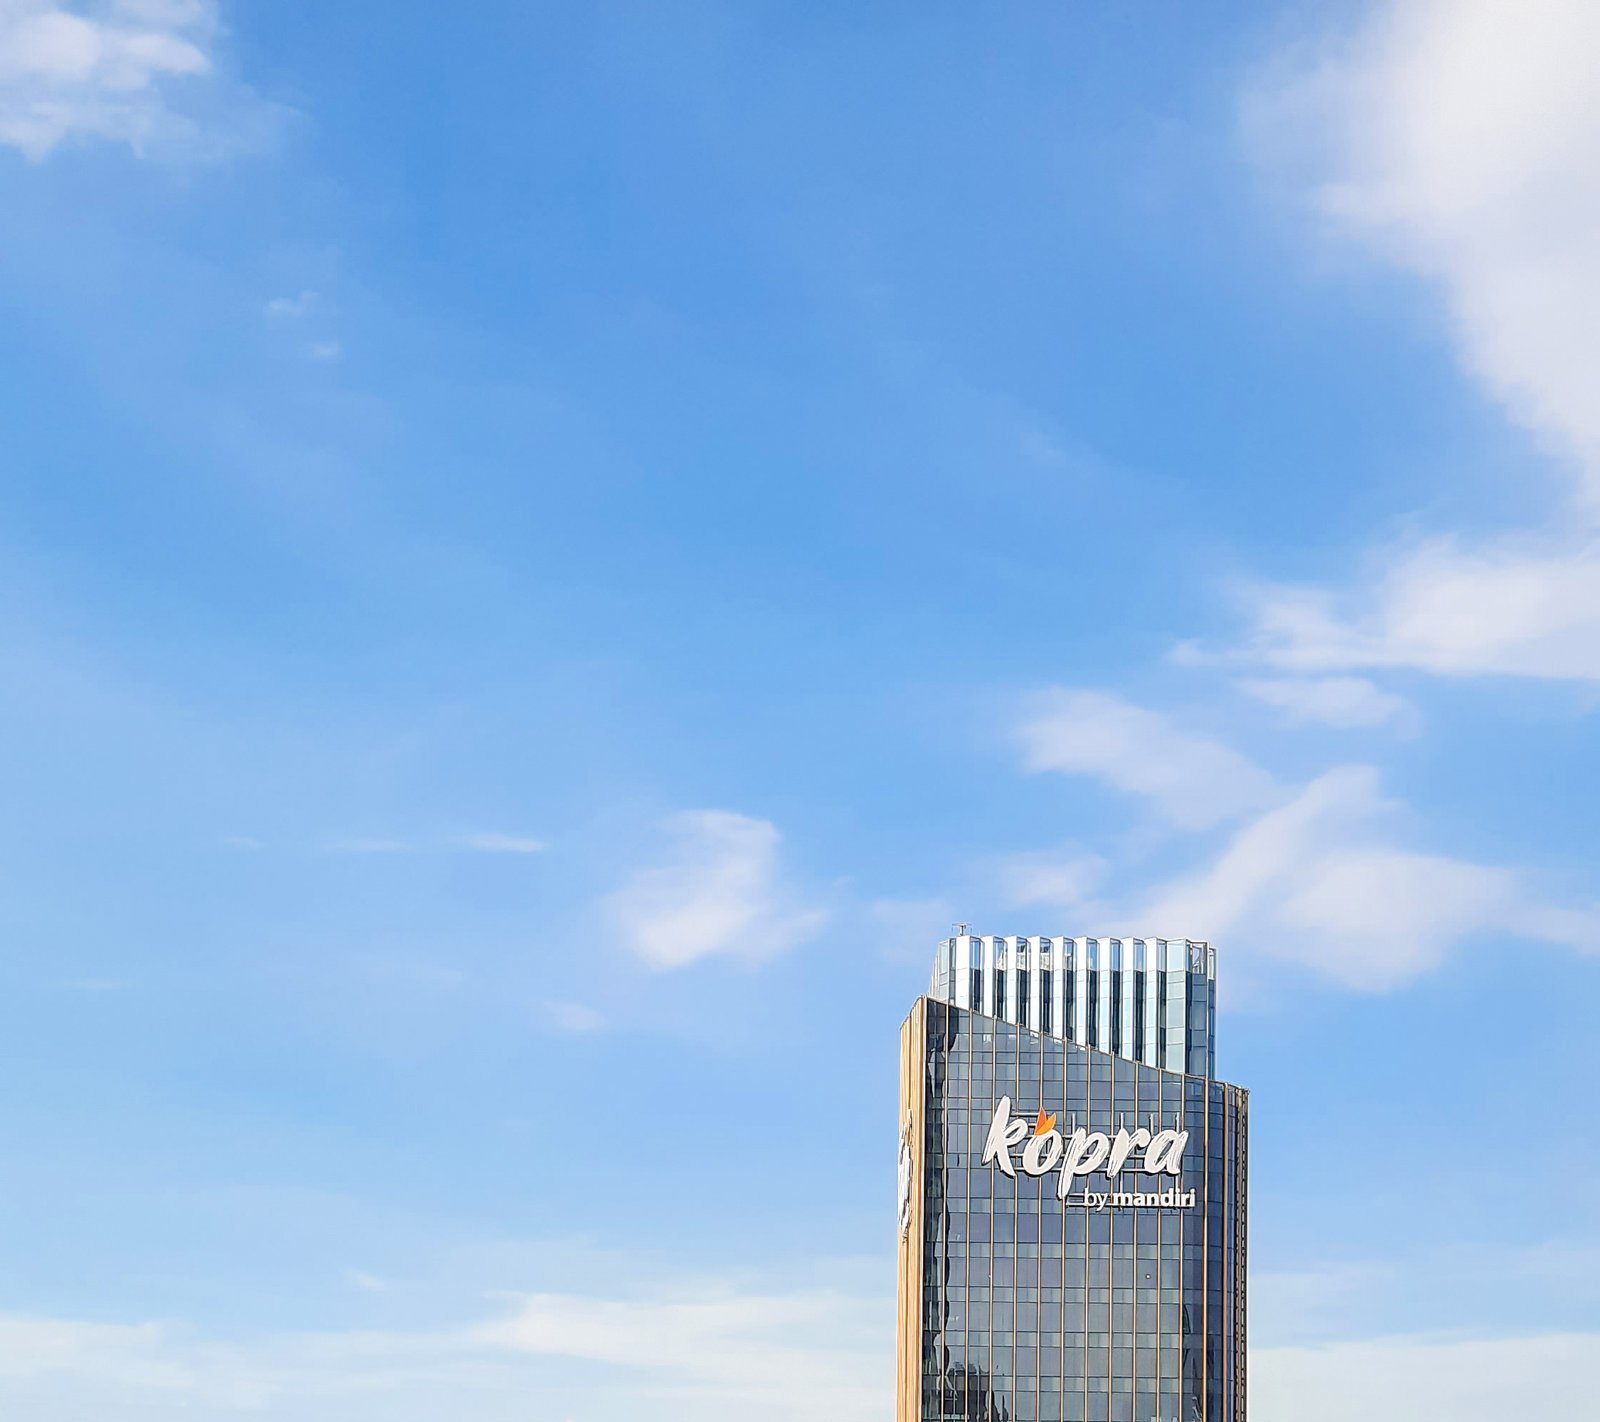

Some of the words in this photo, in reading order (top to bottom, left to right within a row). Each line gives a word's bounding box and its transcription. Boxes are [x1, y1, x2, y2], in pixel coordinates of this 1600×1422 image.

[981, 1095, 1190, 1199] kopra
[1084, 1187, 1108, 1212] by
[1113, 1187, 1196, 1207] mandiri
